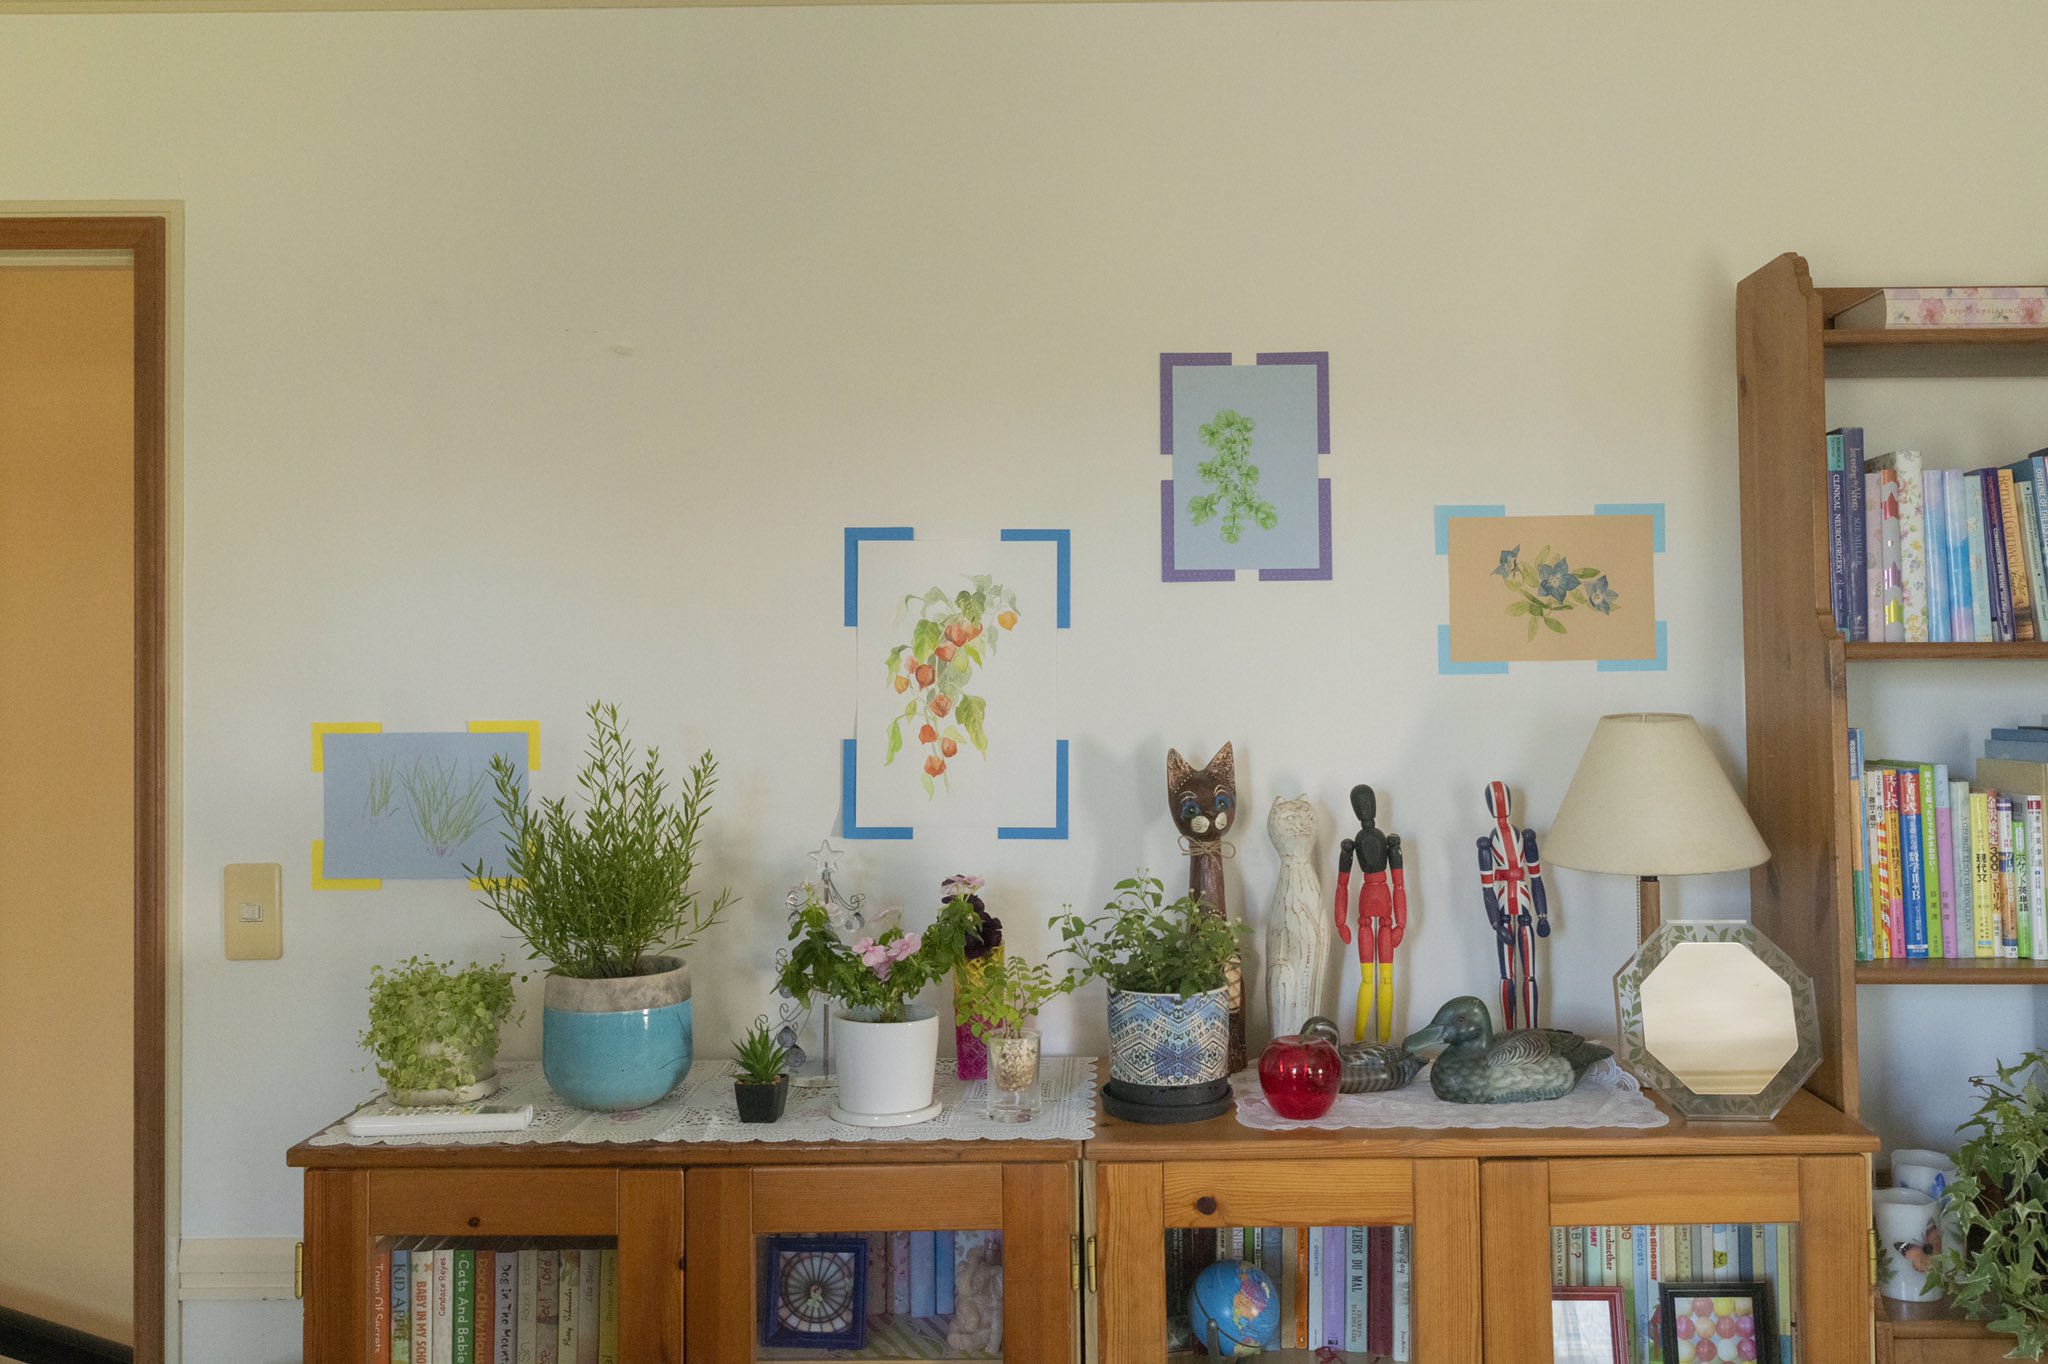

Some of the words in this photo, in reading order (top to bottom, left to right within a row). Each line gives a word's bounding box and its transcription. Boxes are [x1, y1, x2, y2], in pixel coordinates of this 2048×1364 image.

[1832, 474, 1842, 510] CLINICAL
[1999, 475, 2015, 520] Bernard
[2035, 468, 2046, 497] OUTLINE
[2039, 498, 2047, 508] OF
[1853, 516, 1862, 532] SUE
[1834, 513, 1843, 575] NEUROSURGERY
[1854, 534, 1863, 568] MILLER
[2003, 520, 2021, 569] Cornwell
[1885, 775, 1899, 809] チャート式
[1903, 772, 1918, 813] チャート式
[1962, 822, 1970, 854] GEORGE
[1964, 855, 1972, 876] ELIOT
[1976, 853, 1988, 883] 現代文
[2016, 853, 2029, 912] ポケット英単語
[1964, 877, 1973, 931] CHRONOLOGY
[1396, 1226, 1409, 1255] Snowy
[1637, 1232, 1646, 1267] Secrets
[439, 1257, 449, 1281] Reyes
[499, 1263, 512, 1285] Dog
[1351, 1259, 1363, 1271] DU
[1396, 1258, 1409, 1275] day
[1556, 1254, 1563, 1265] ON
[1651, 1237, 1659, 1281] dinosaur
[375, 1263, 384, 1293] Town
[393, 1263, 407, 1292] KID
[457, 1259, 469, 1293] Cats
[477, 1258, 488, 1291] Door
[1351, 1274, 1363, 1294] MAL
[375, 1296, 384, 1311] Of
[416, 1280, 428, 1308] BABY
[438, 1283, 447, 1317] Candace
[478, 1293, 488, 1310] Of
[500, 1287, 512, 1300] In
[562, 1286, 573, 1323] Schneider
[393, 1297, 408, 1343] APPLE
[415, 1310, 427, 1321] IN
[457, 1297, 469, 1324] And
[475, 1311, 487, 1330] My
[500, 1303, 512, 1325] The
[1356, 1309, 1364, 1339] CHARLES
[375, 1313, 384, 1354] Secrets
[416, 1323, 427, 1338] MY
[456, 1327, 469, 1364] Babie
[500, 1328, 512, 1364] Mount
